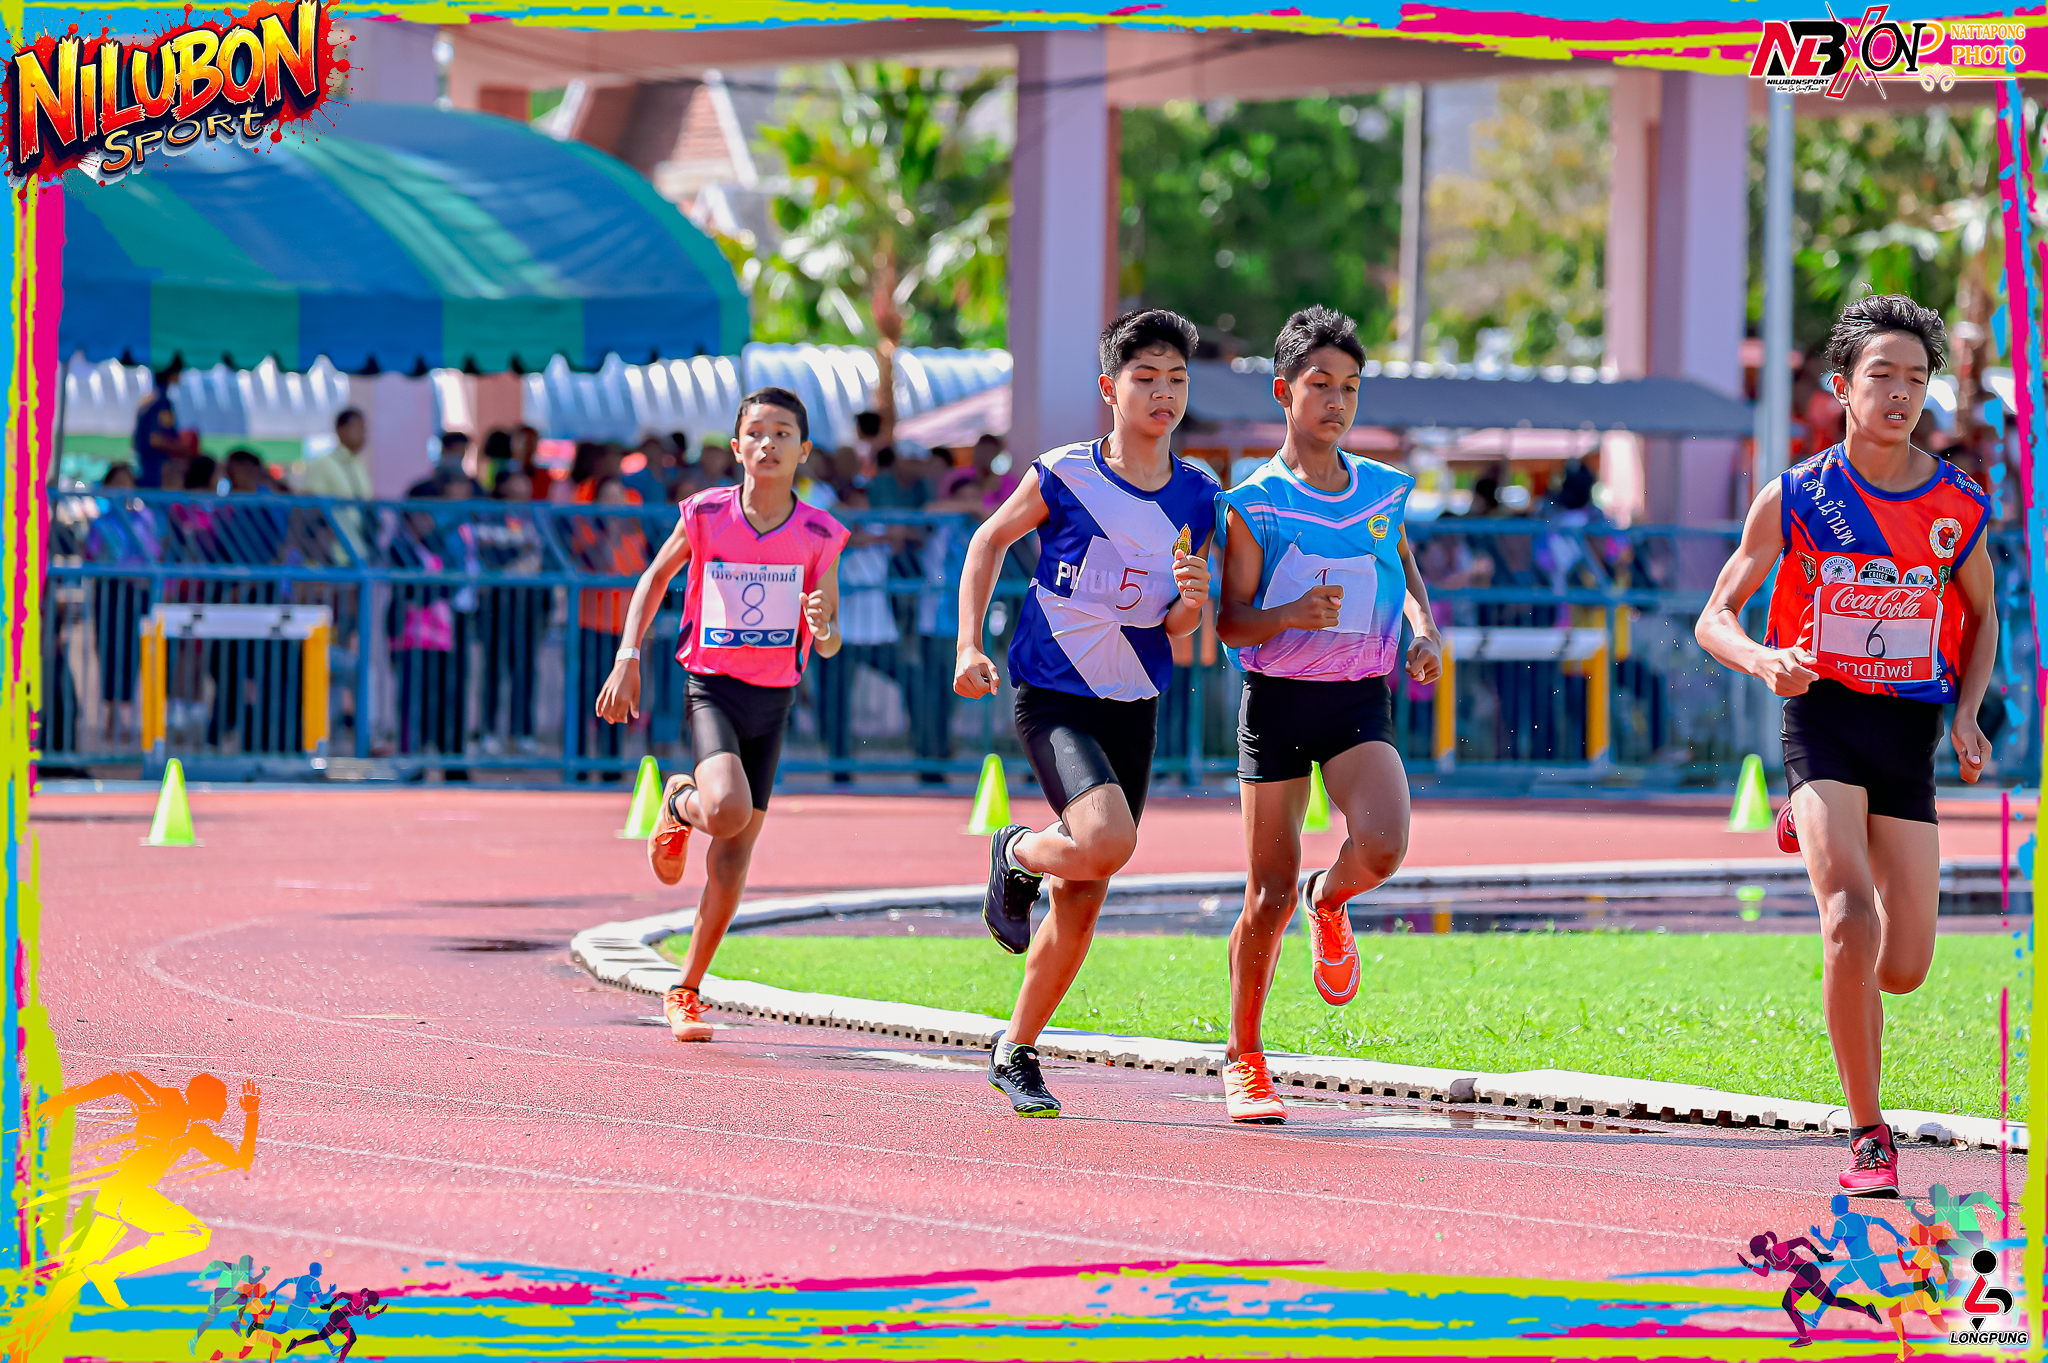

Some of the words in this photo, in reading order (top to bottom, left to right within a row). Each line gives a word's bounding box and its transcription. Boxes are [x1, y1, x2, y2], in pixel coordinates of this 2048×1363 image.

[741, 582, 765, 626] 8
[1115, 567, 1149, 610] 5
[1830, 586, 1928, 618] Coca-Cola
[1866, 619, 1887, 658] 6
